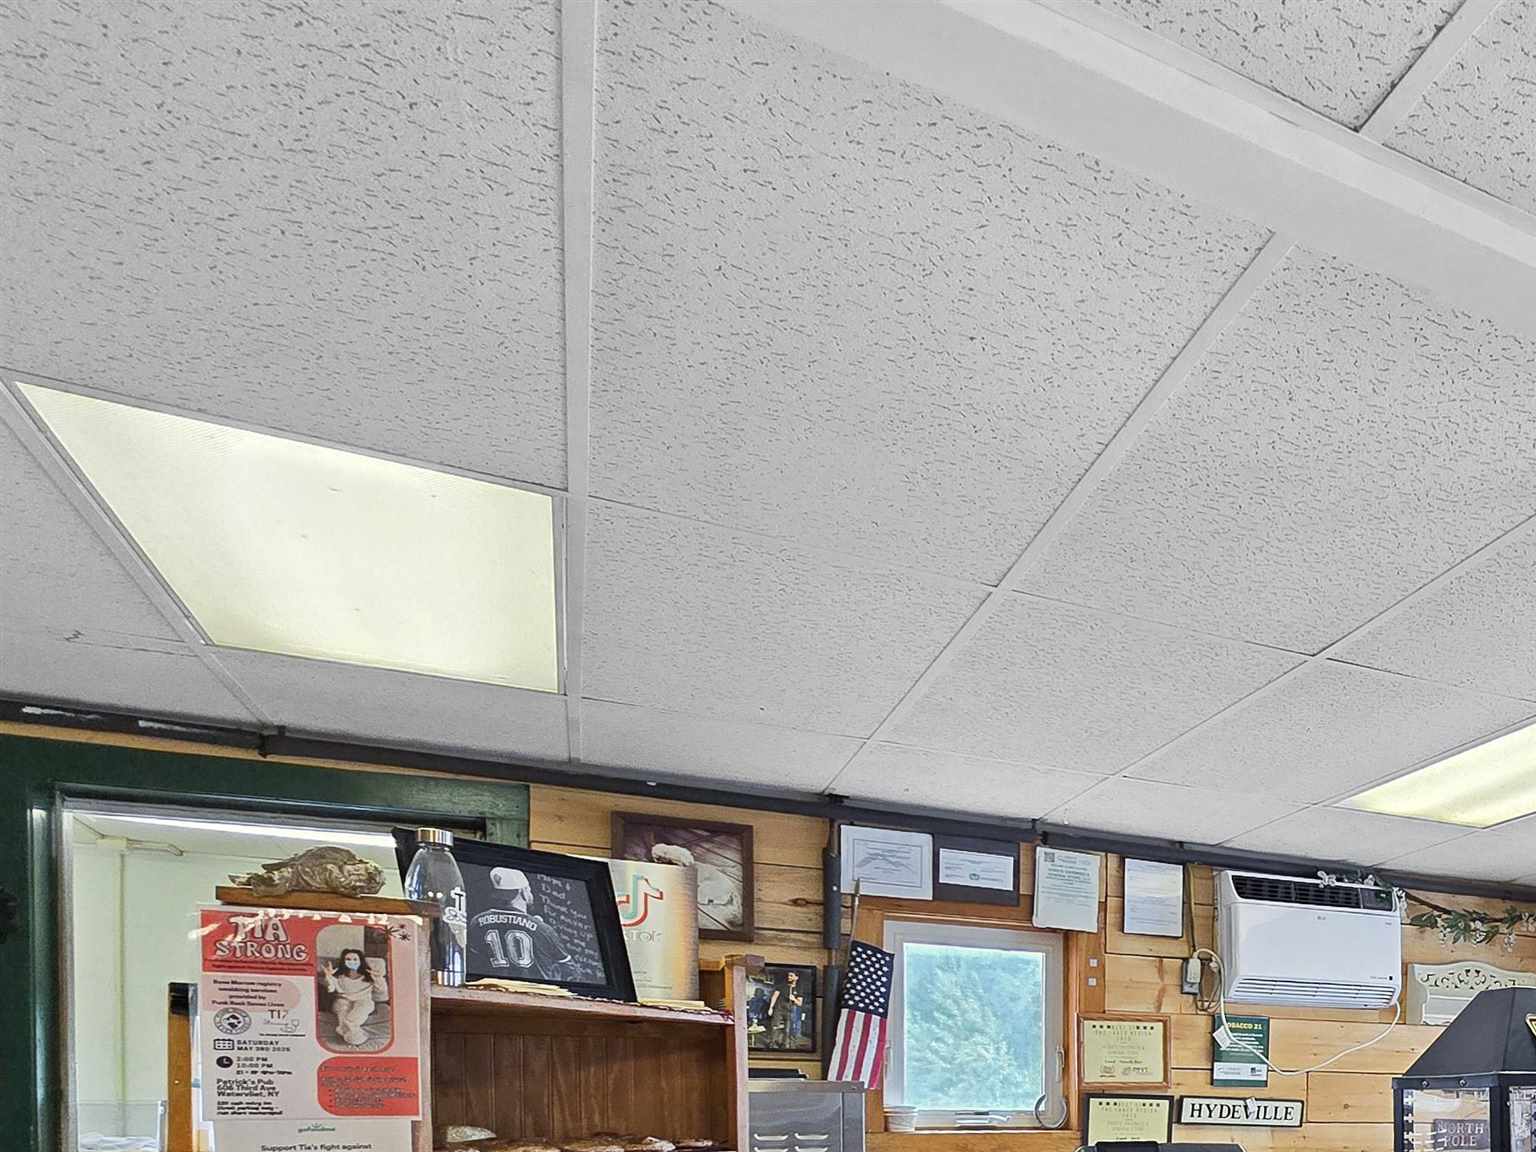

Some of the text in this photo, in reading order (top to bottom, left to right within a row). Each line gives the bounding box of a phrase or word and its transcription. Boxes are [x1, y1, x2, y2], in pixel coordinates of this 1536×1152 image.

[478, 914, 538, 931] ROBUSTIANO
[215, 940, 309, 961] STRONG
[484, 929, 535, 968] 10
[1227, 1022, 1253, 1030] OBACCO
[1189, 1102, 1295, 1121] HYDEVILLE
[261, 1144, 297, 1152] Support
[320, 1143, 340, 1151] fight
